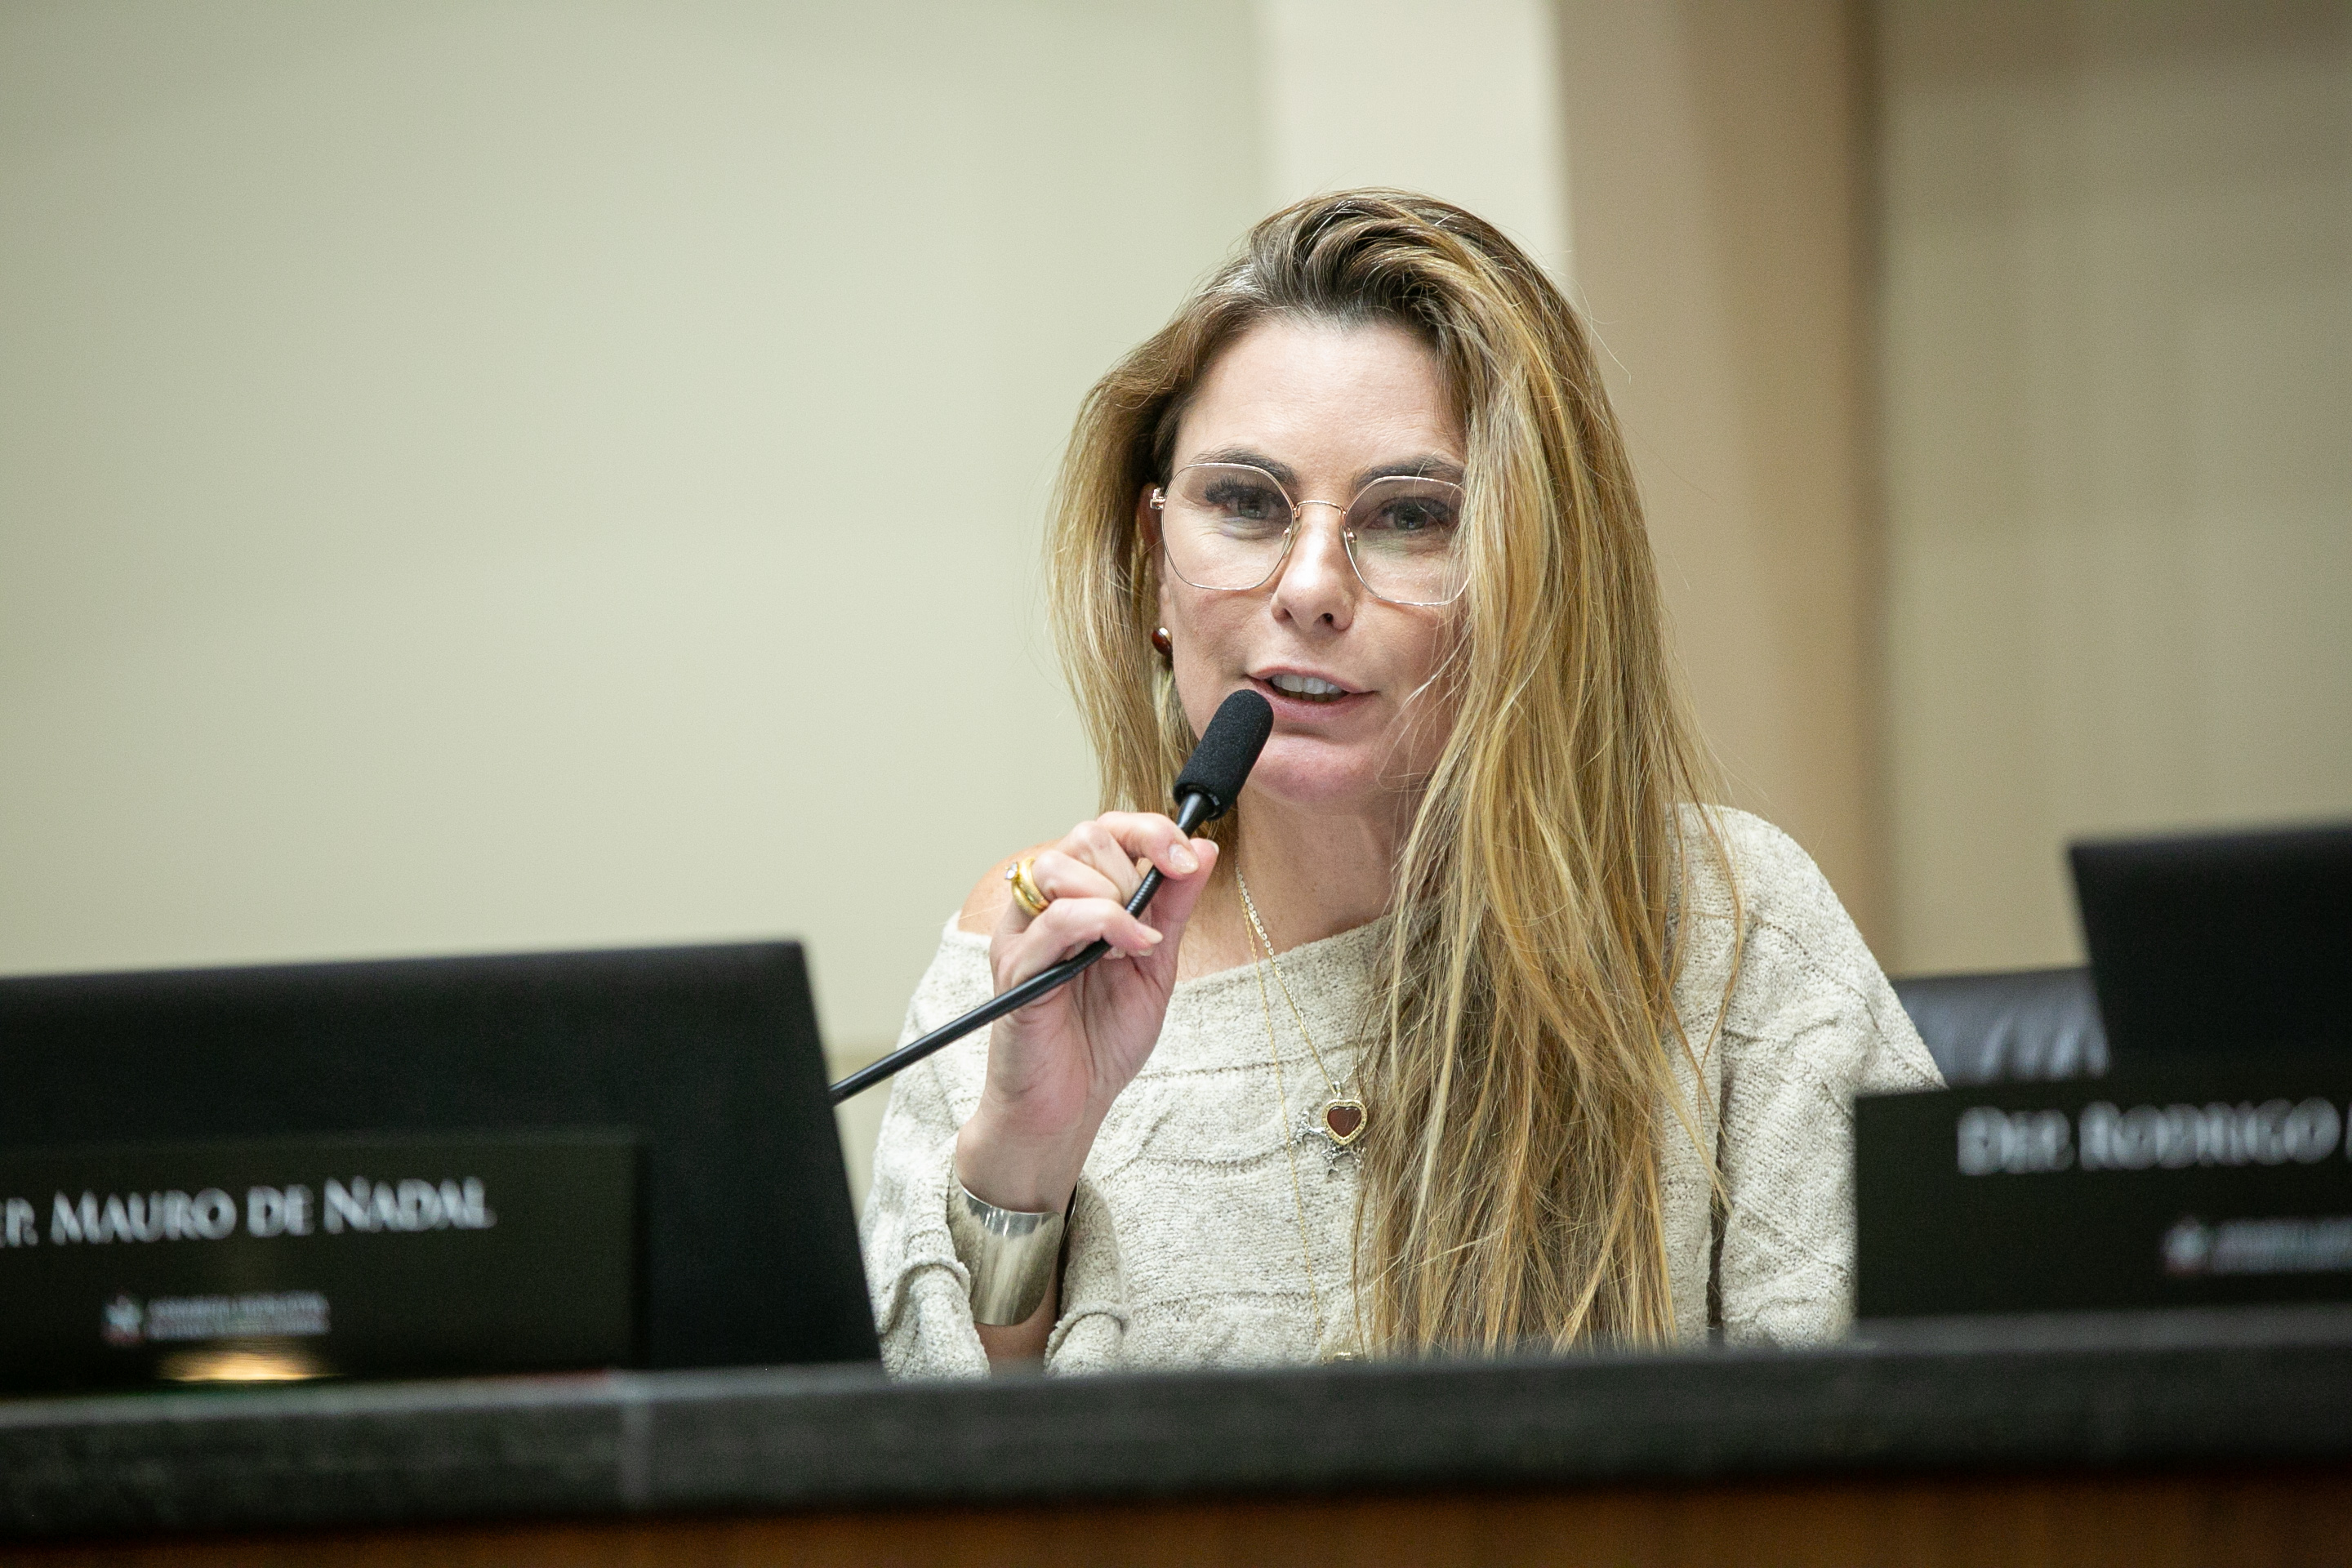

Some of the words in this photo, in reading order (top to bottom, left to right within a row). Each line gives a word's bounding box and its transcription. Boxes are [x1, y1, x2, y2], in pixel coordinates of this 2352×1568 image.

[2078, 1096, 2341, 1171] RODRIGO
[51, 1188, 238, 1245] MAURO
[247, 1184, 315, 1238] DE
[324, 1175, 497, 1234] NADAL
